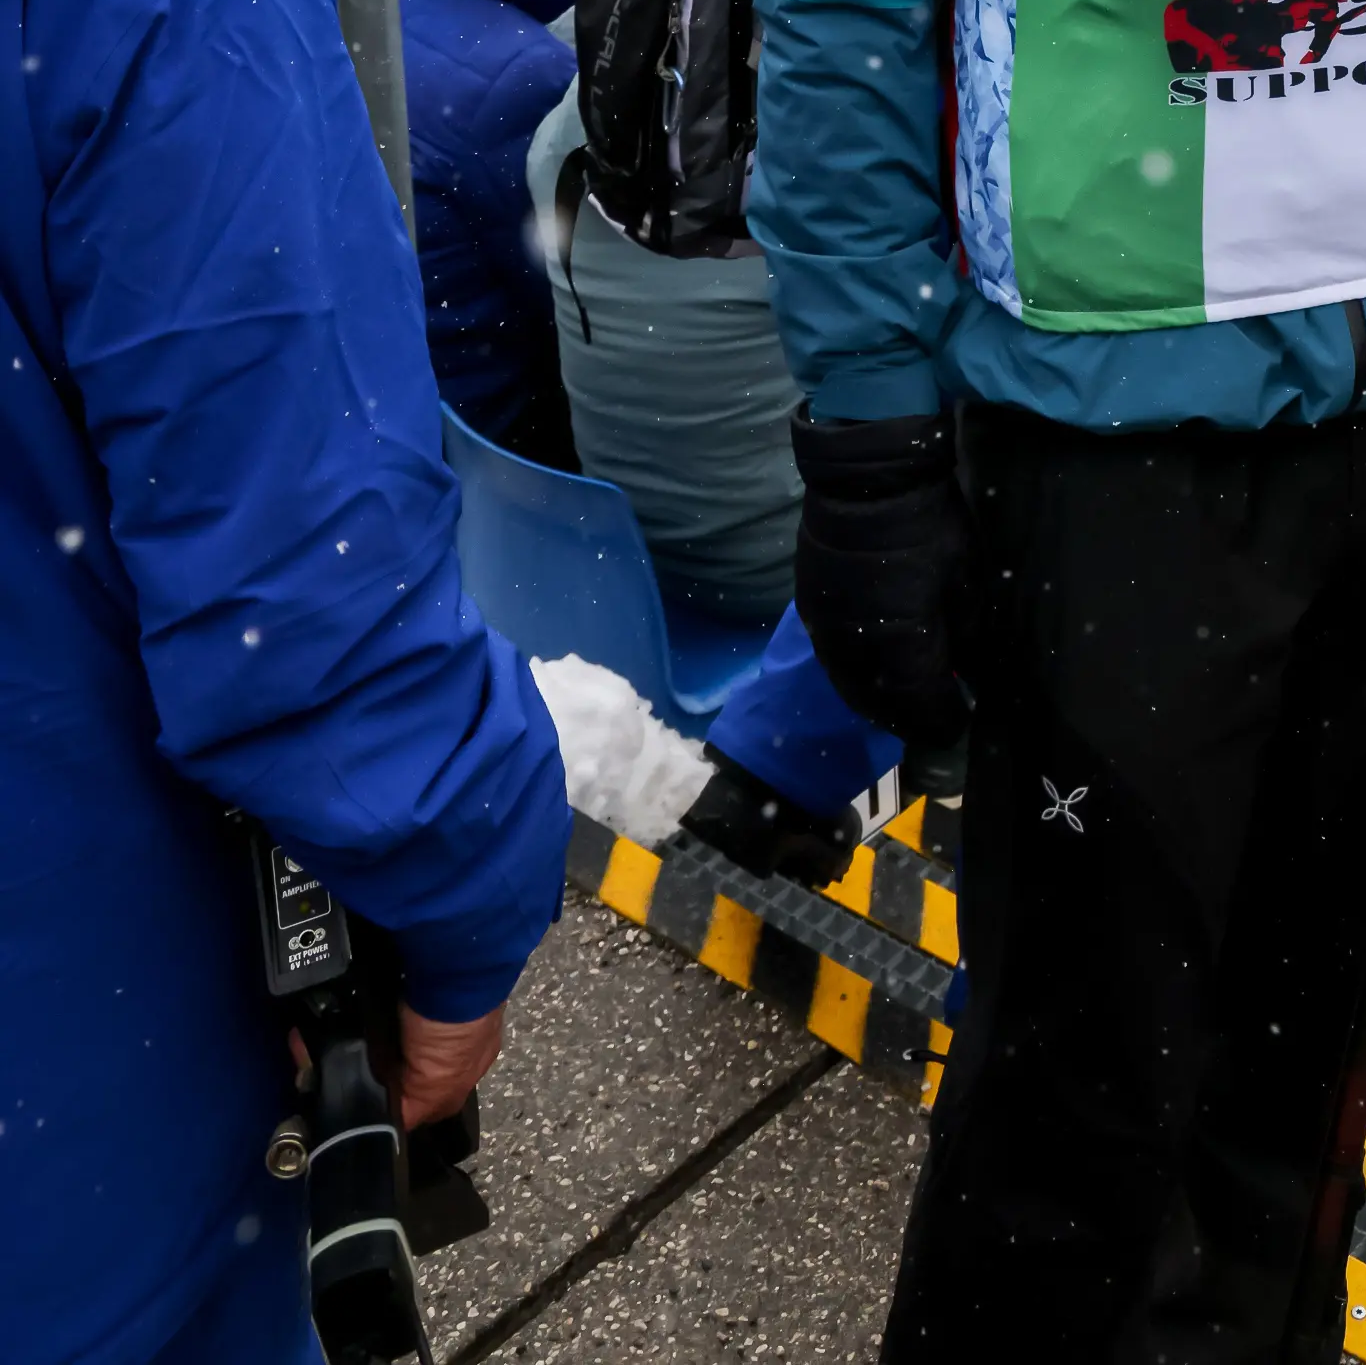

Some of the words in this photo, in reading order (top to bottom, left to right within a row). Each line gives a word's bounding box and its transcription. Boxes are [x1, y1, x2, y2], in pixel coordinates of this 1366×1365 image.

[280, 875, 291, 885] ON
[288, 951, 303, 963] EXT
[302, 943, 329, 959] POWER
